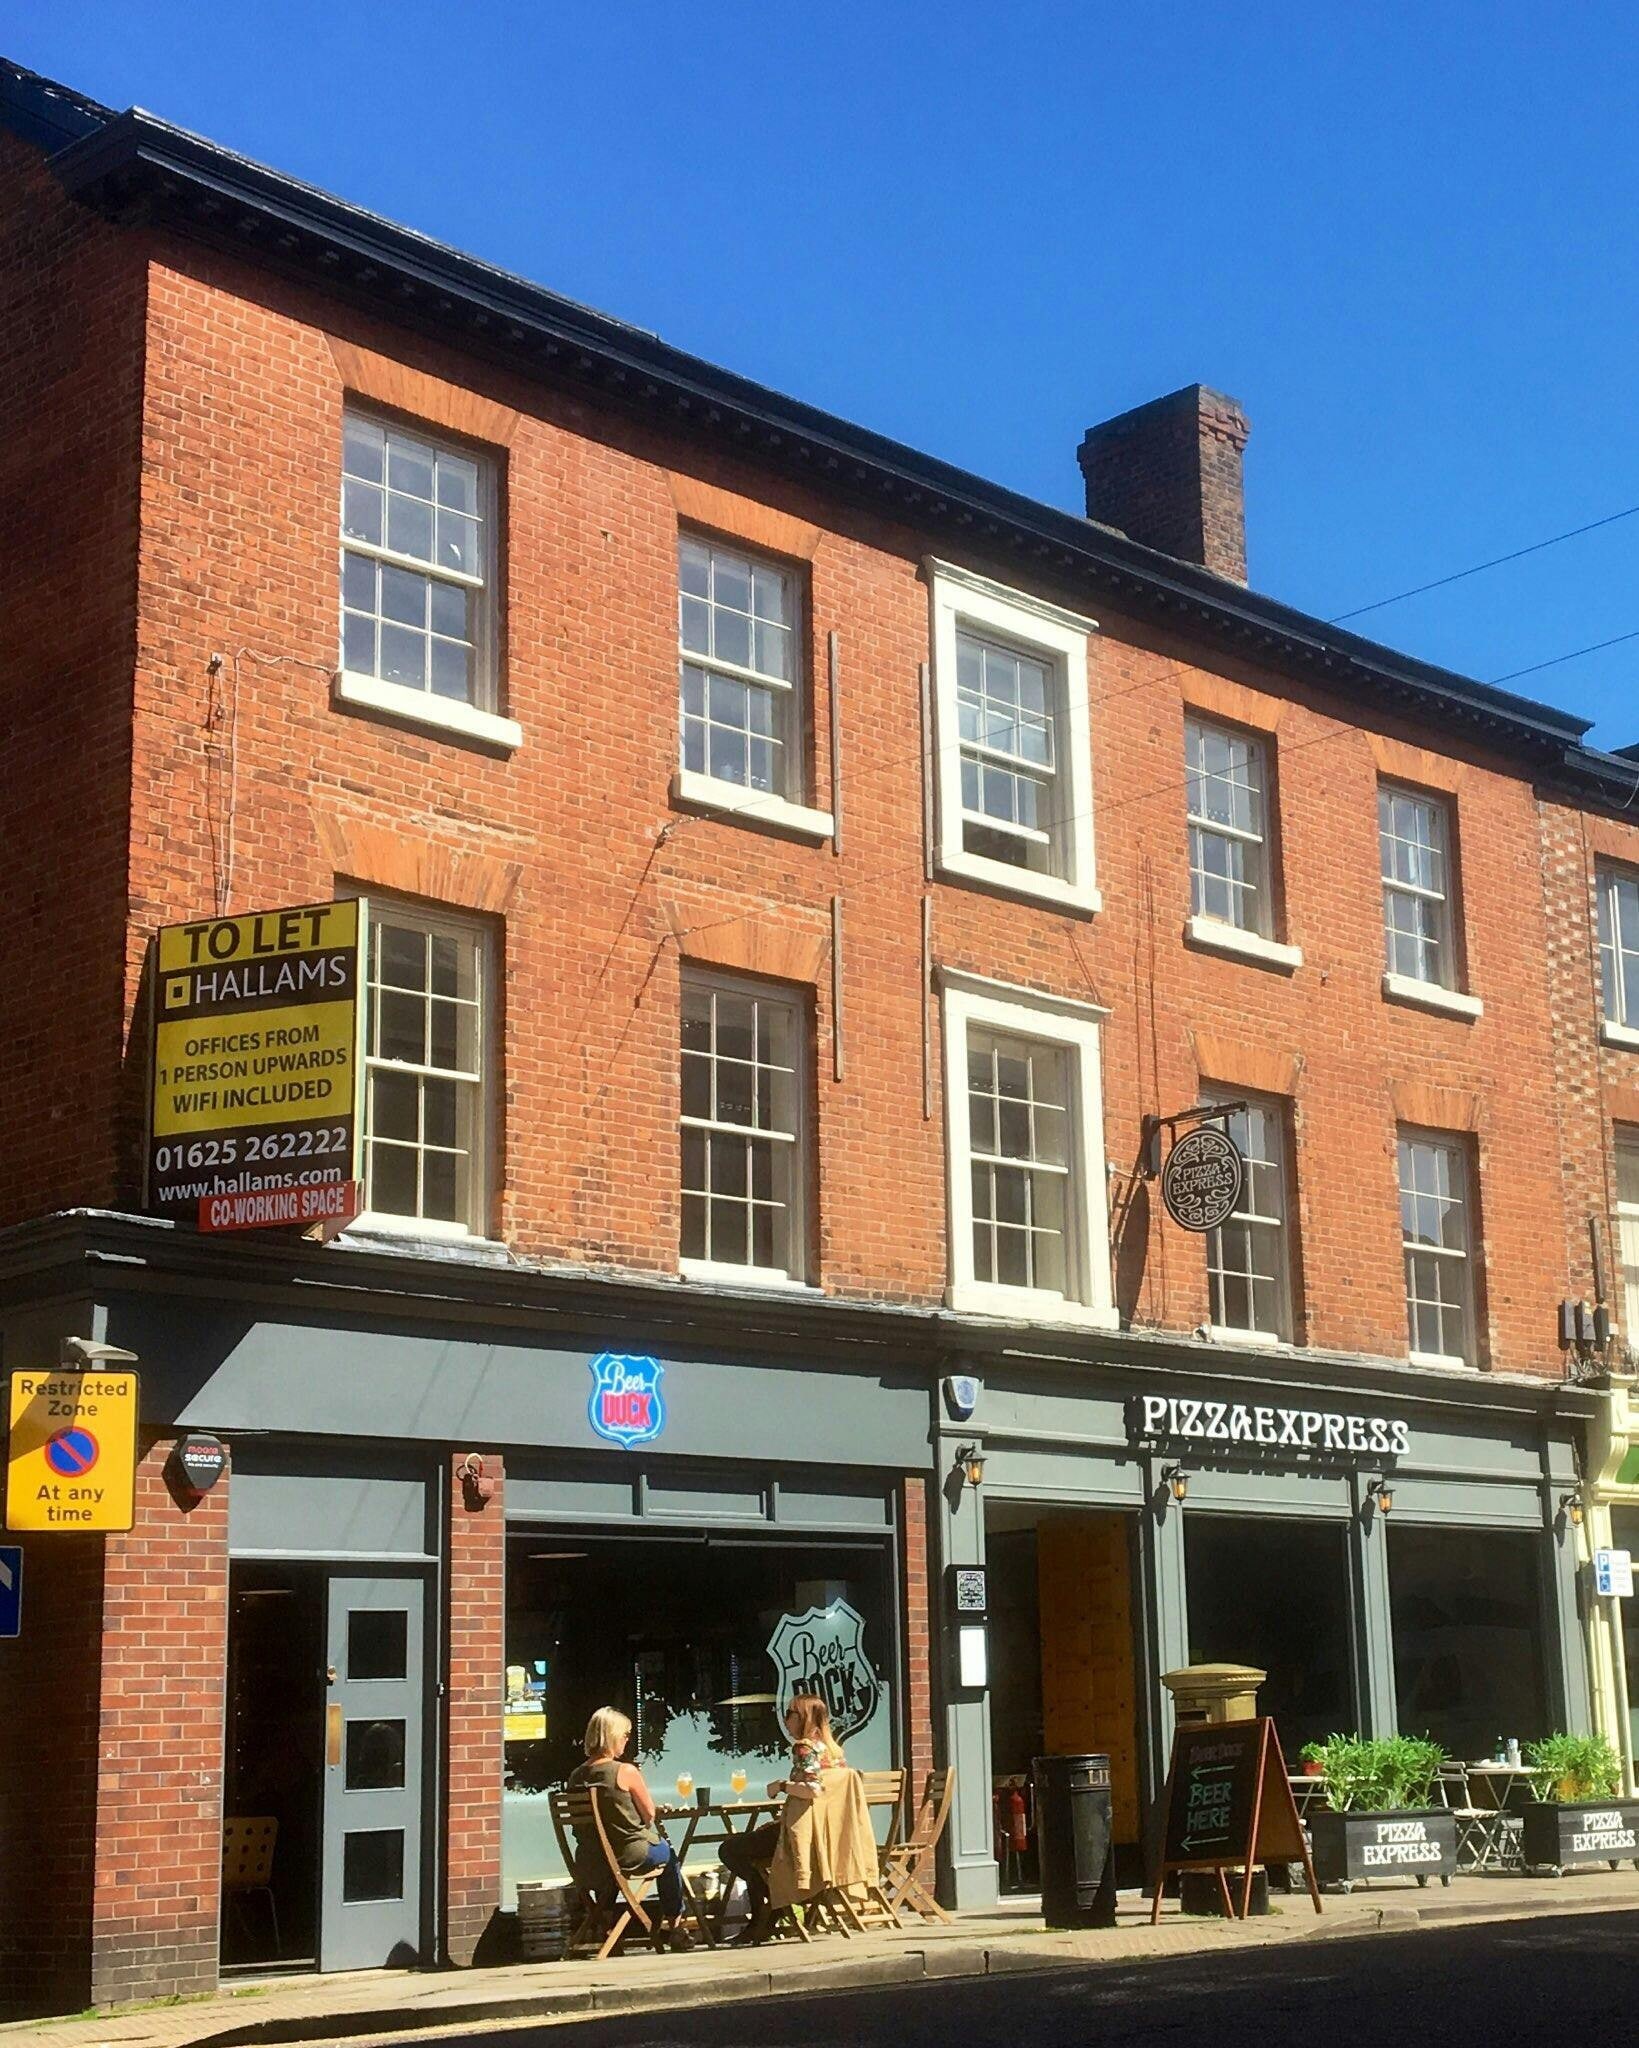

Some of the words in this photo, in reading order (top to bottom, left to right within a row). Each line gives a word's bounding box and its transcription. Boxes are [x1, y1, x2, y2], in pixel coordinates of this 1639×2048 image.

[184, 920, 241, 965] TO
[253, 907, 332, 955] LET
[194, 955, 347, 1005] HALLAMS
[185, 1031, 261, 1057] OFFICES
[266, 1024, 320, 1047] FROM
[160, 1068, 168, 1086] 1
[173, 1060, 248, 1084] PERSON
[253, 1048, 347, 1076] UPWARDS
[173, 1090, 218, 1114] WIFI
[223, 1078, 333, 1109] INCLUDED
[156, 1139, 237, 1173] 01625
[244, 1127, 348, 1163] 262222
[158, 1167, 342, 1201] www.hallams.com
[1172, 1172, 1233, 1195] EXPRESS
[1182, 1162, 1221, 1181] PIZZA
[210, 1192, 297, 1227] CO-WORKING
[301, 1187, 345, 1217] SPACE
[20, 1380, 128, 1396] Restricted
[603, 1360, 646, 1396] Beer
[48, 1401, 98, 1416] Zone
[184, 1454, 222, 1463] secure
[37, 1485, 60, 1500] At
[68, 1487, 105, 1503] any
[47, 1506, 93, 1521] time
[790, 1631, 846, 1678] Beer
[1189, 1782, 1232, 1807] BEER
[1186, 1808, 1230, 1832] HERE
[1376, 1821, 1427, 1843] PIZZA
[1583, 1811, 1624, 1831] PIZZA
[1573, 1829, 1636, 1852] EXPRESS
[1363, 1841, 1442, 1866] EXPRESS
